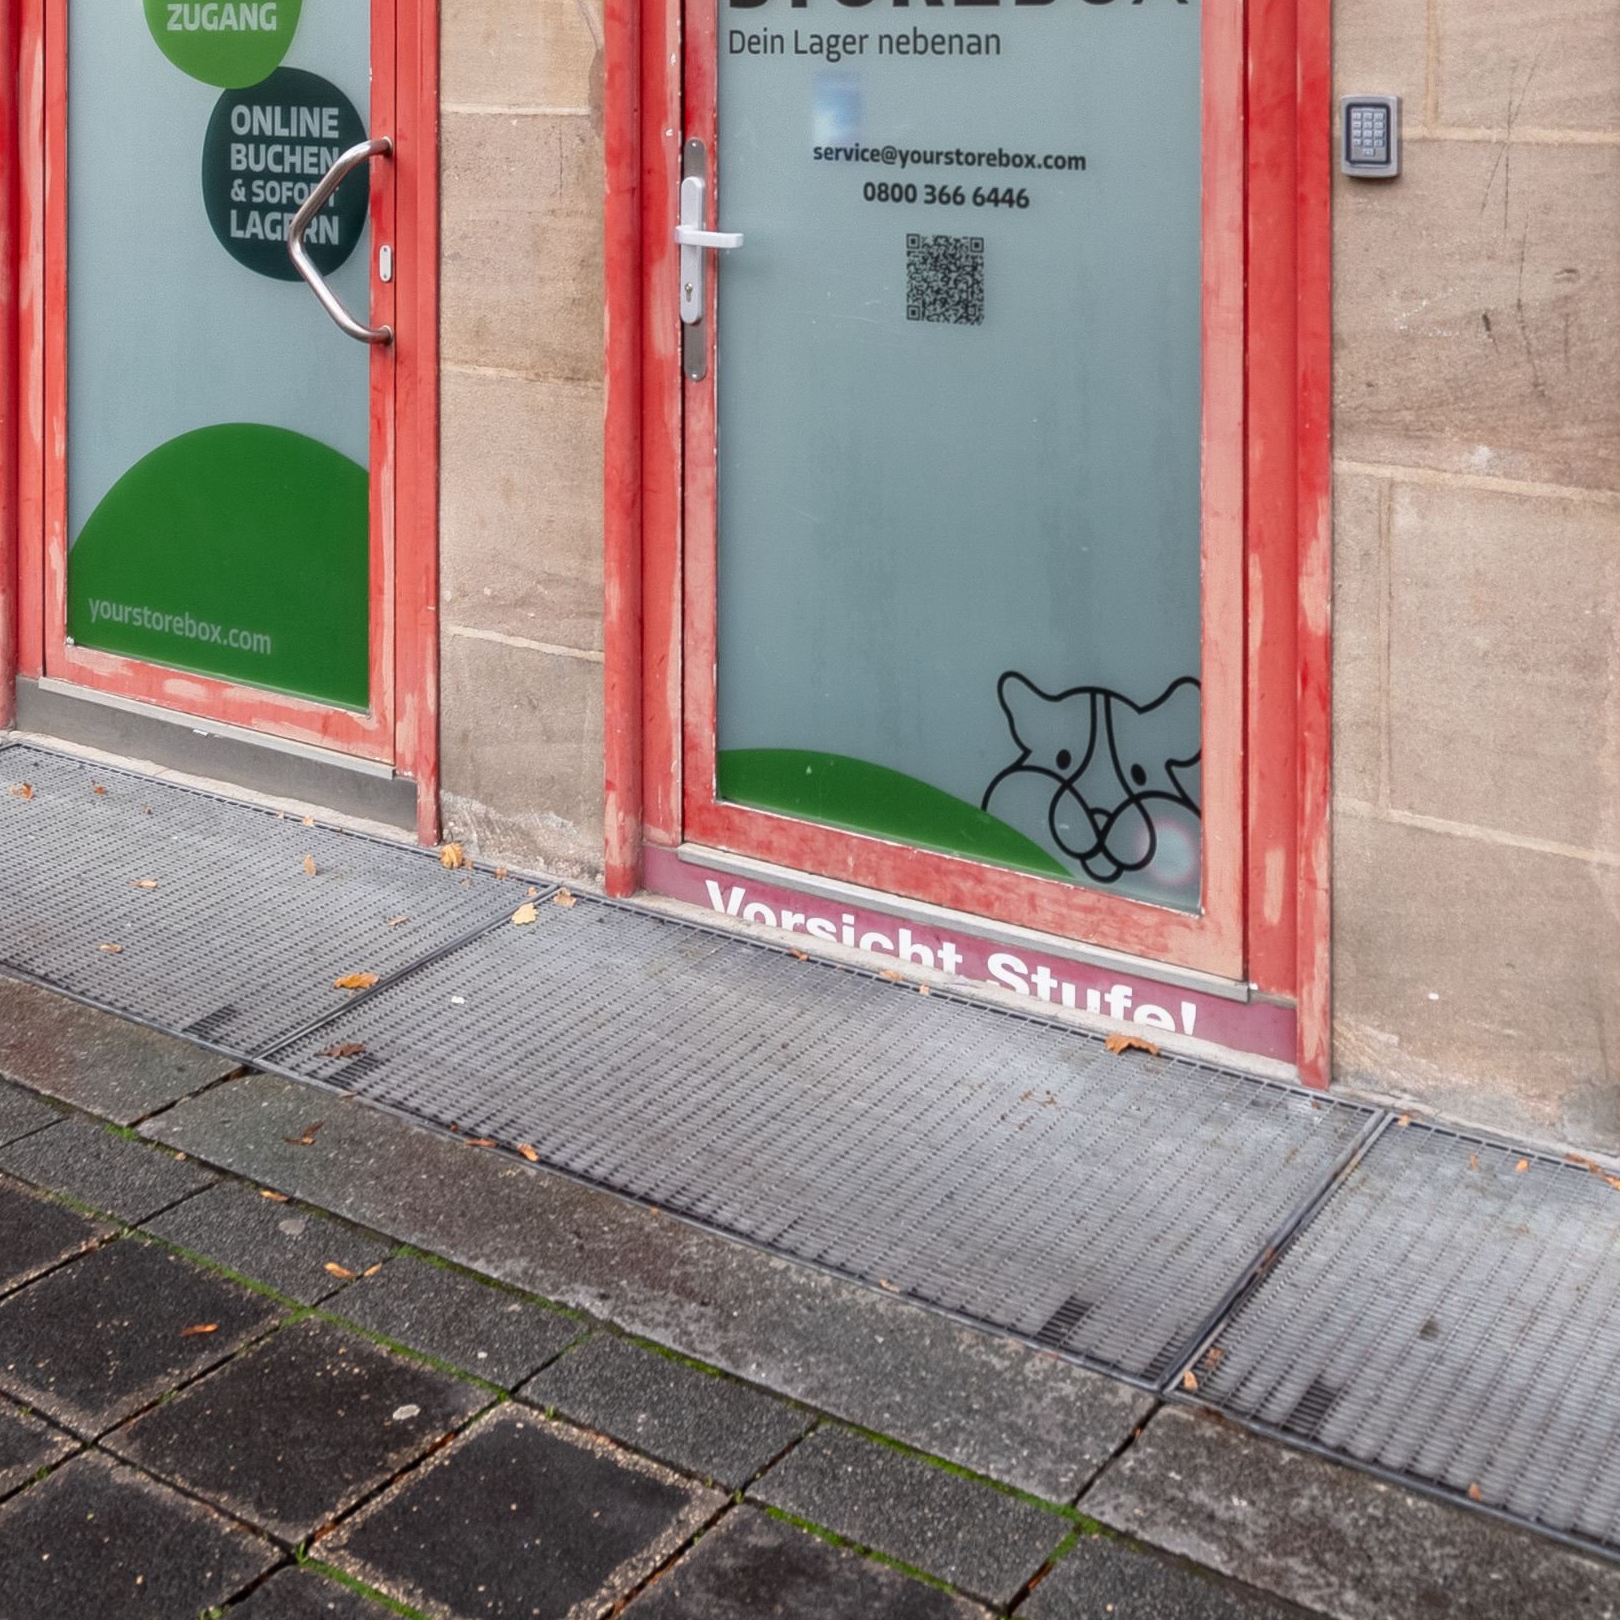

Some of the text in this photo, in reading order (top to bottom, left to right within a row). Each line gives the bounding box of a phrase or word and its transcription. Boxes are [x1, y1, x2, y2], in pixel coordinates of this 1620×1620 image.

[166, 1, 277, 31] ZUGANG
[729, 26, 1002, 64] Dein Lager nebenan
[230, 104, 339, 139] ONLINE
[230, 143, 339, 175] BUCHEN
[812, 143, 1086, 171] service@yourstorebox.com
[231, 178, 339, 208] & SOFOT
[863, 181, 1030, 210] 0800 366 6446
[88, 597, 272, 655] yourstorebox.com
